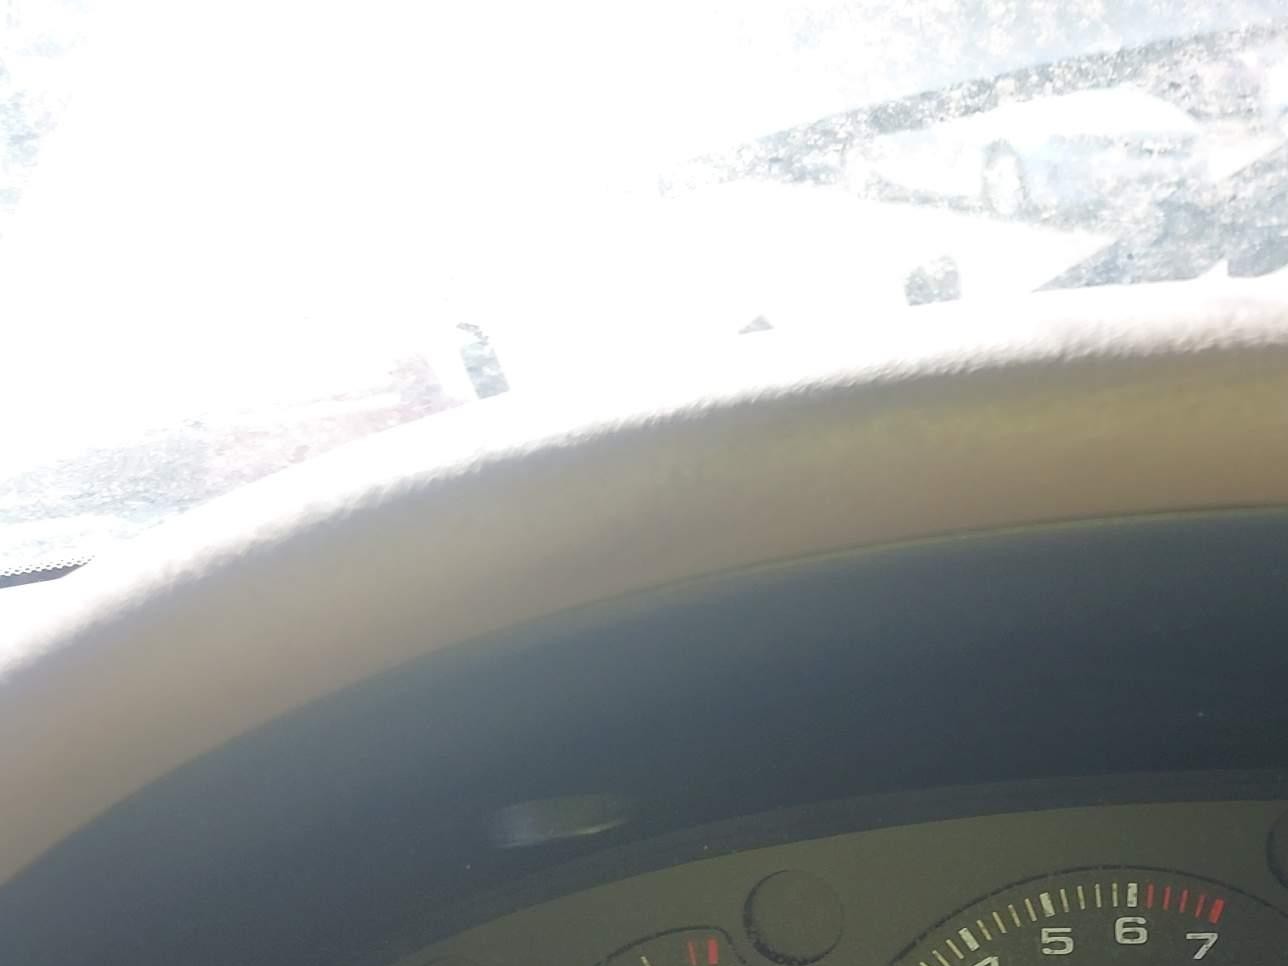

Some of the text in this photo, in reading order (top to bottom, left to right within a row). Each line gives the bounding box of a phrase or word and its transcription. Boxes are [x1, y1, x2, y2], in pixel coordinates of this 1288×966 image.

[1042, 928, 1073, 954] 5
[1116, 917, 1147, 944] 6
[1187, 933, 1218, 959] 7
